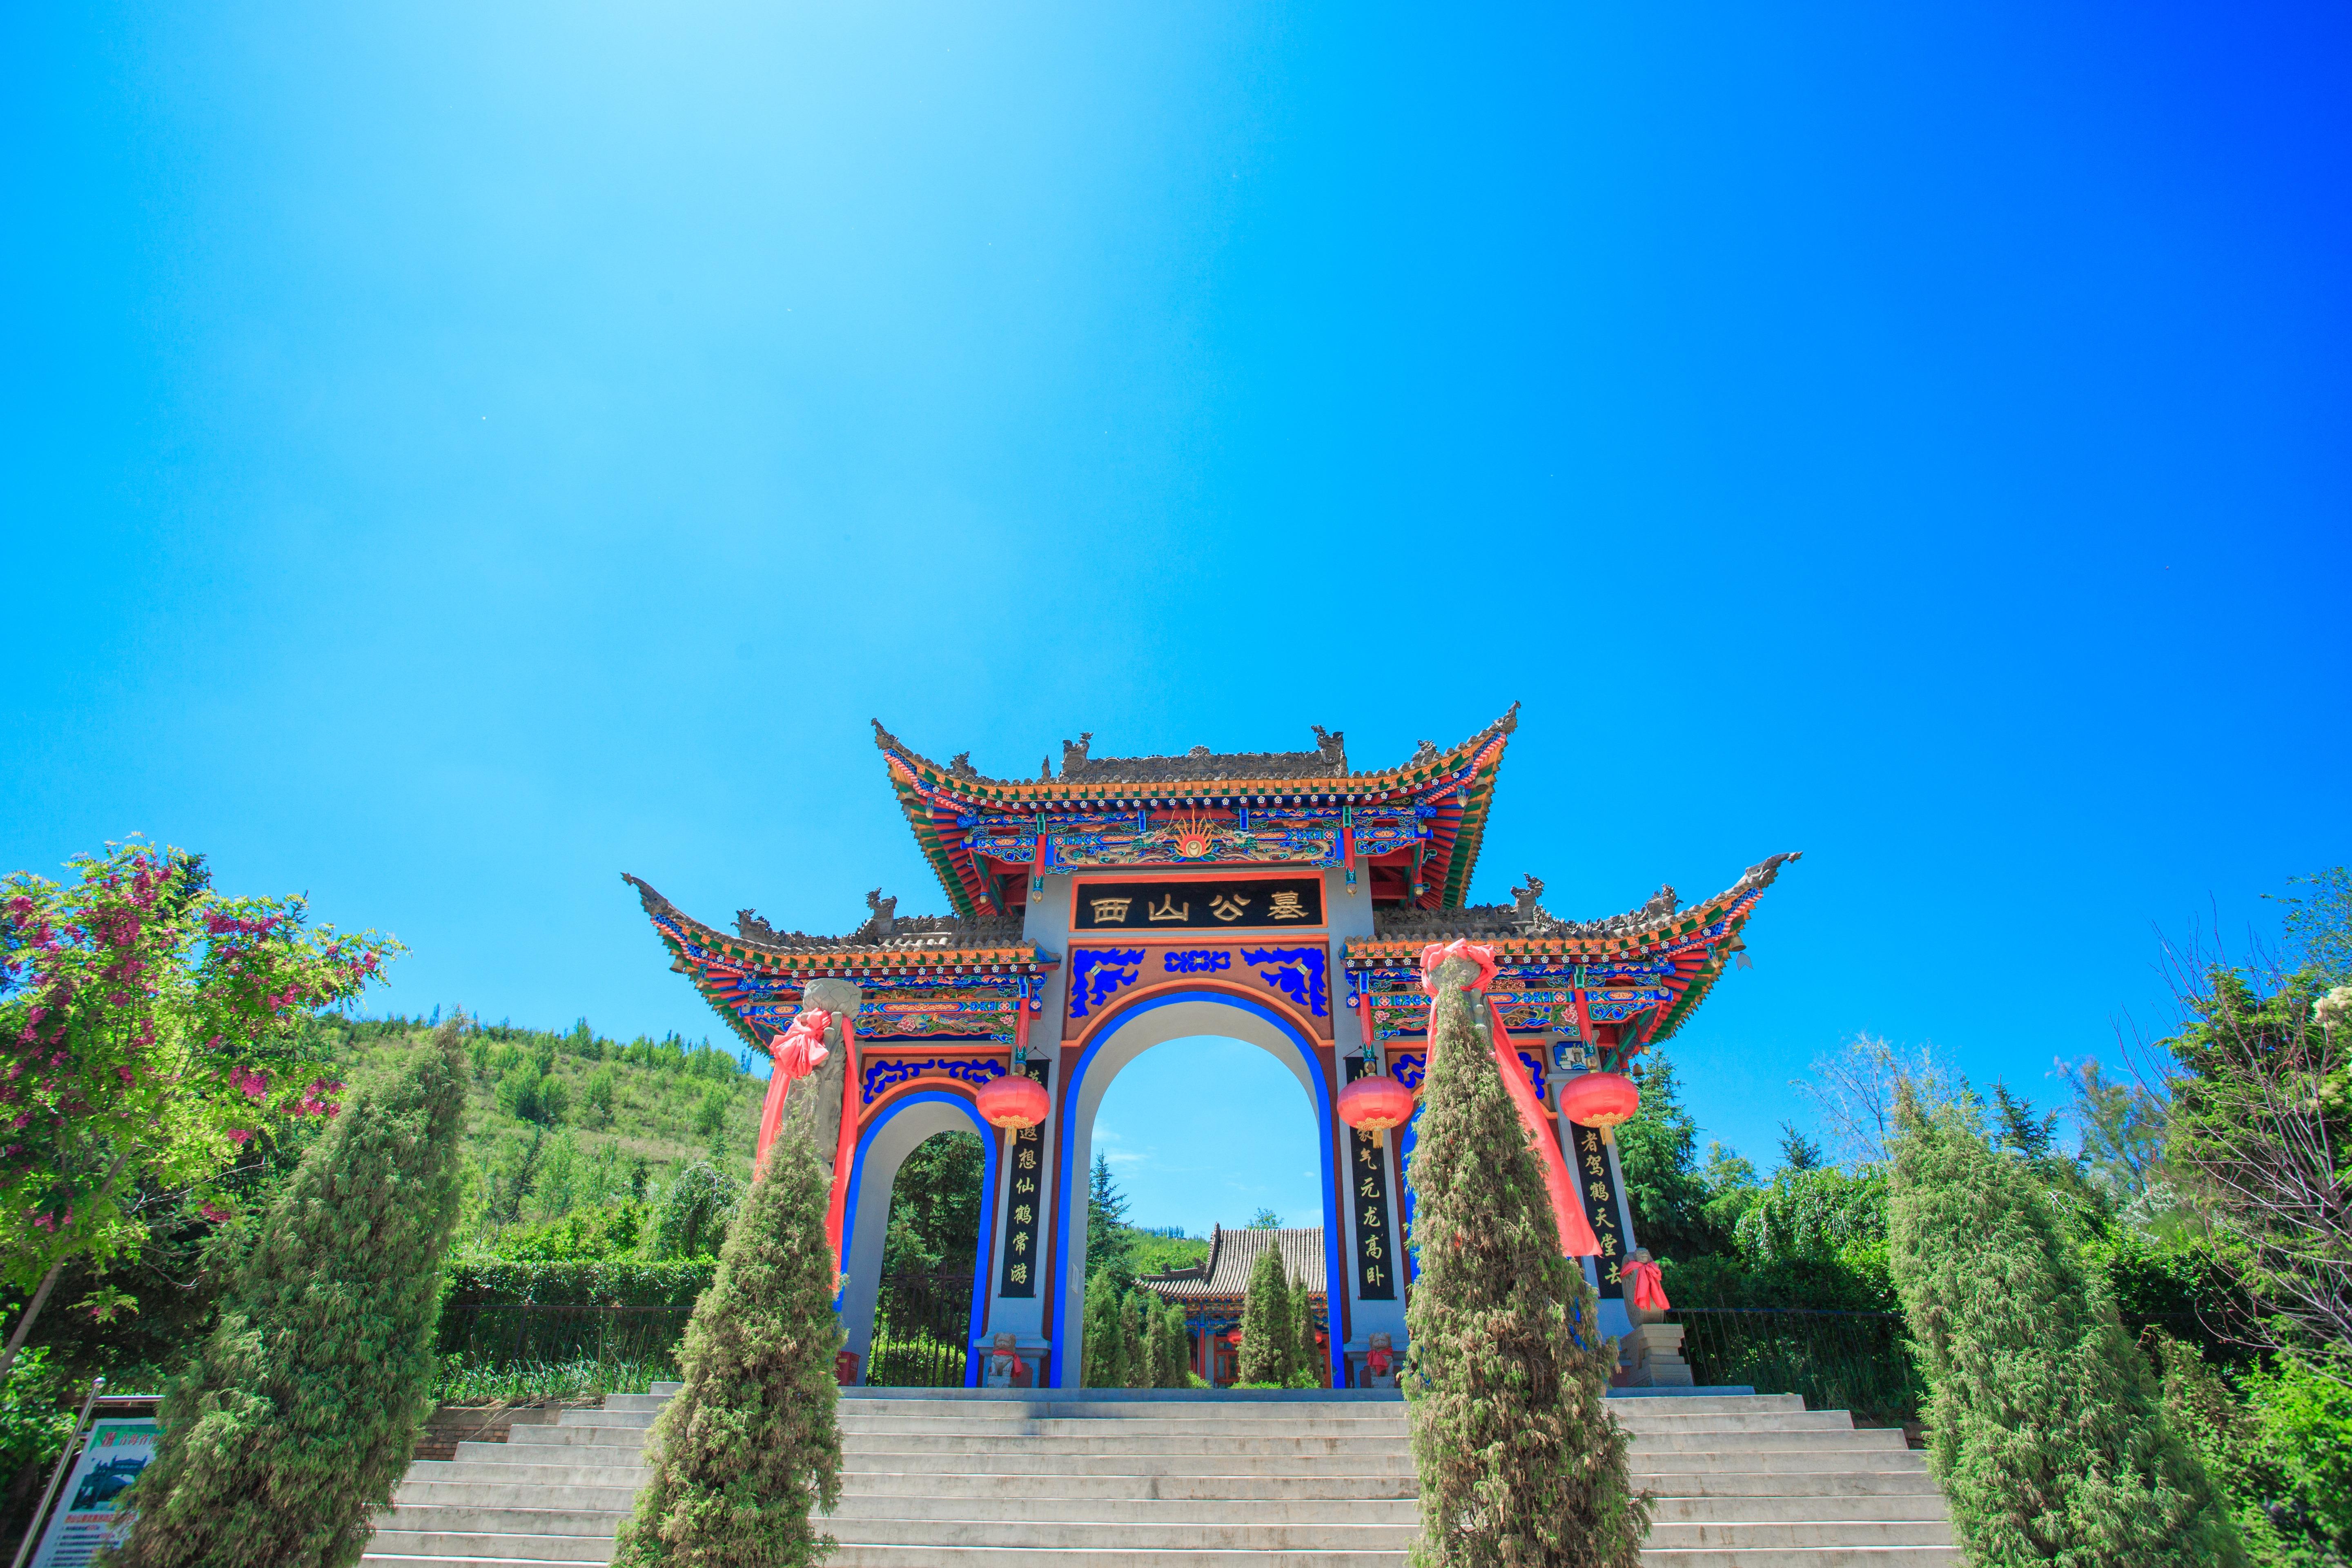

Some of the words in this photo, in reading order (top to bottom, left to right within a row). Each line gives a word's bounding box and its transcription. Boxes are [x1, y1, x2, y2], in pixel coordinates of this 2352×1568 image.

[1090, 891, 1308, 924] 西山公墓
[1581, 1130, 1622, 1285] 者驾鹤天堂去
